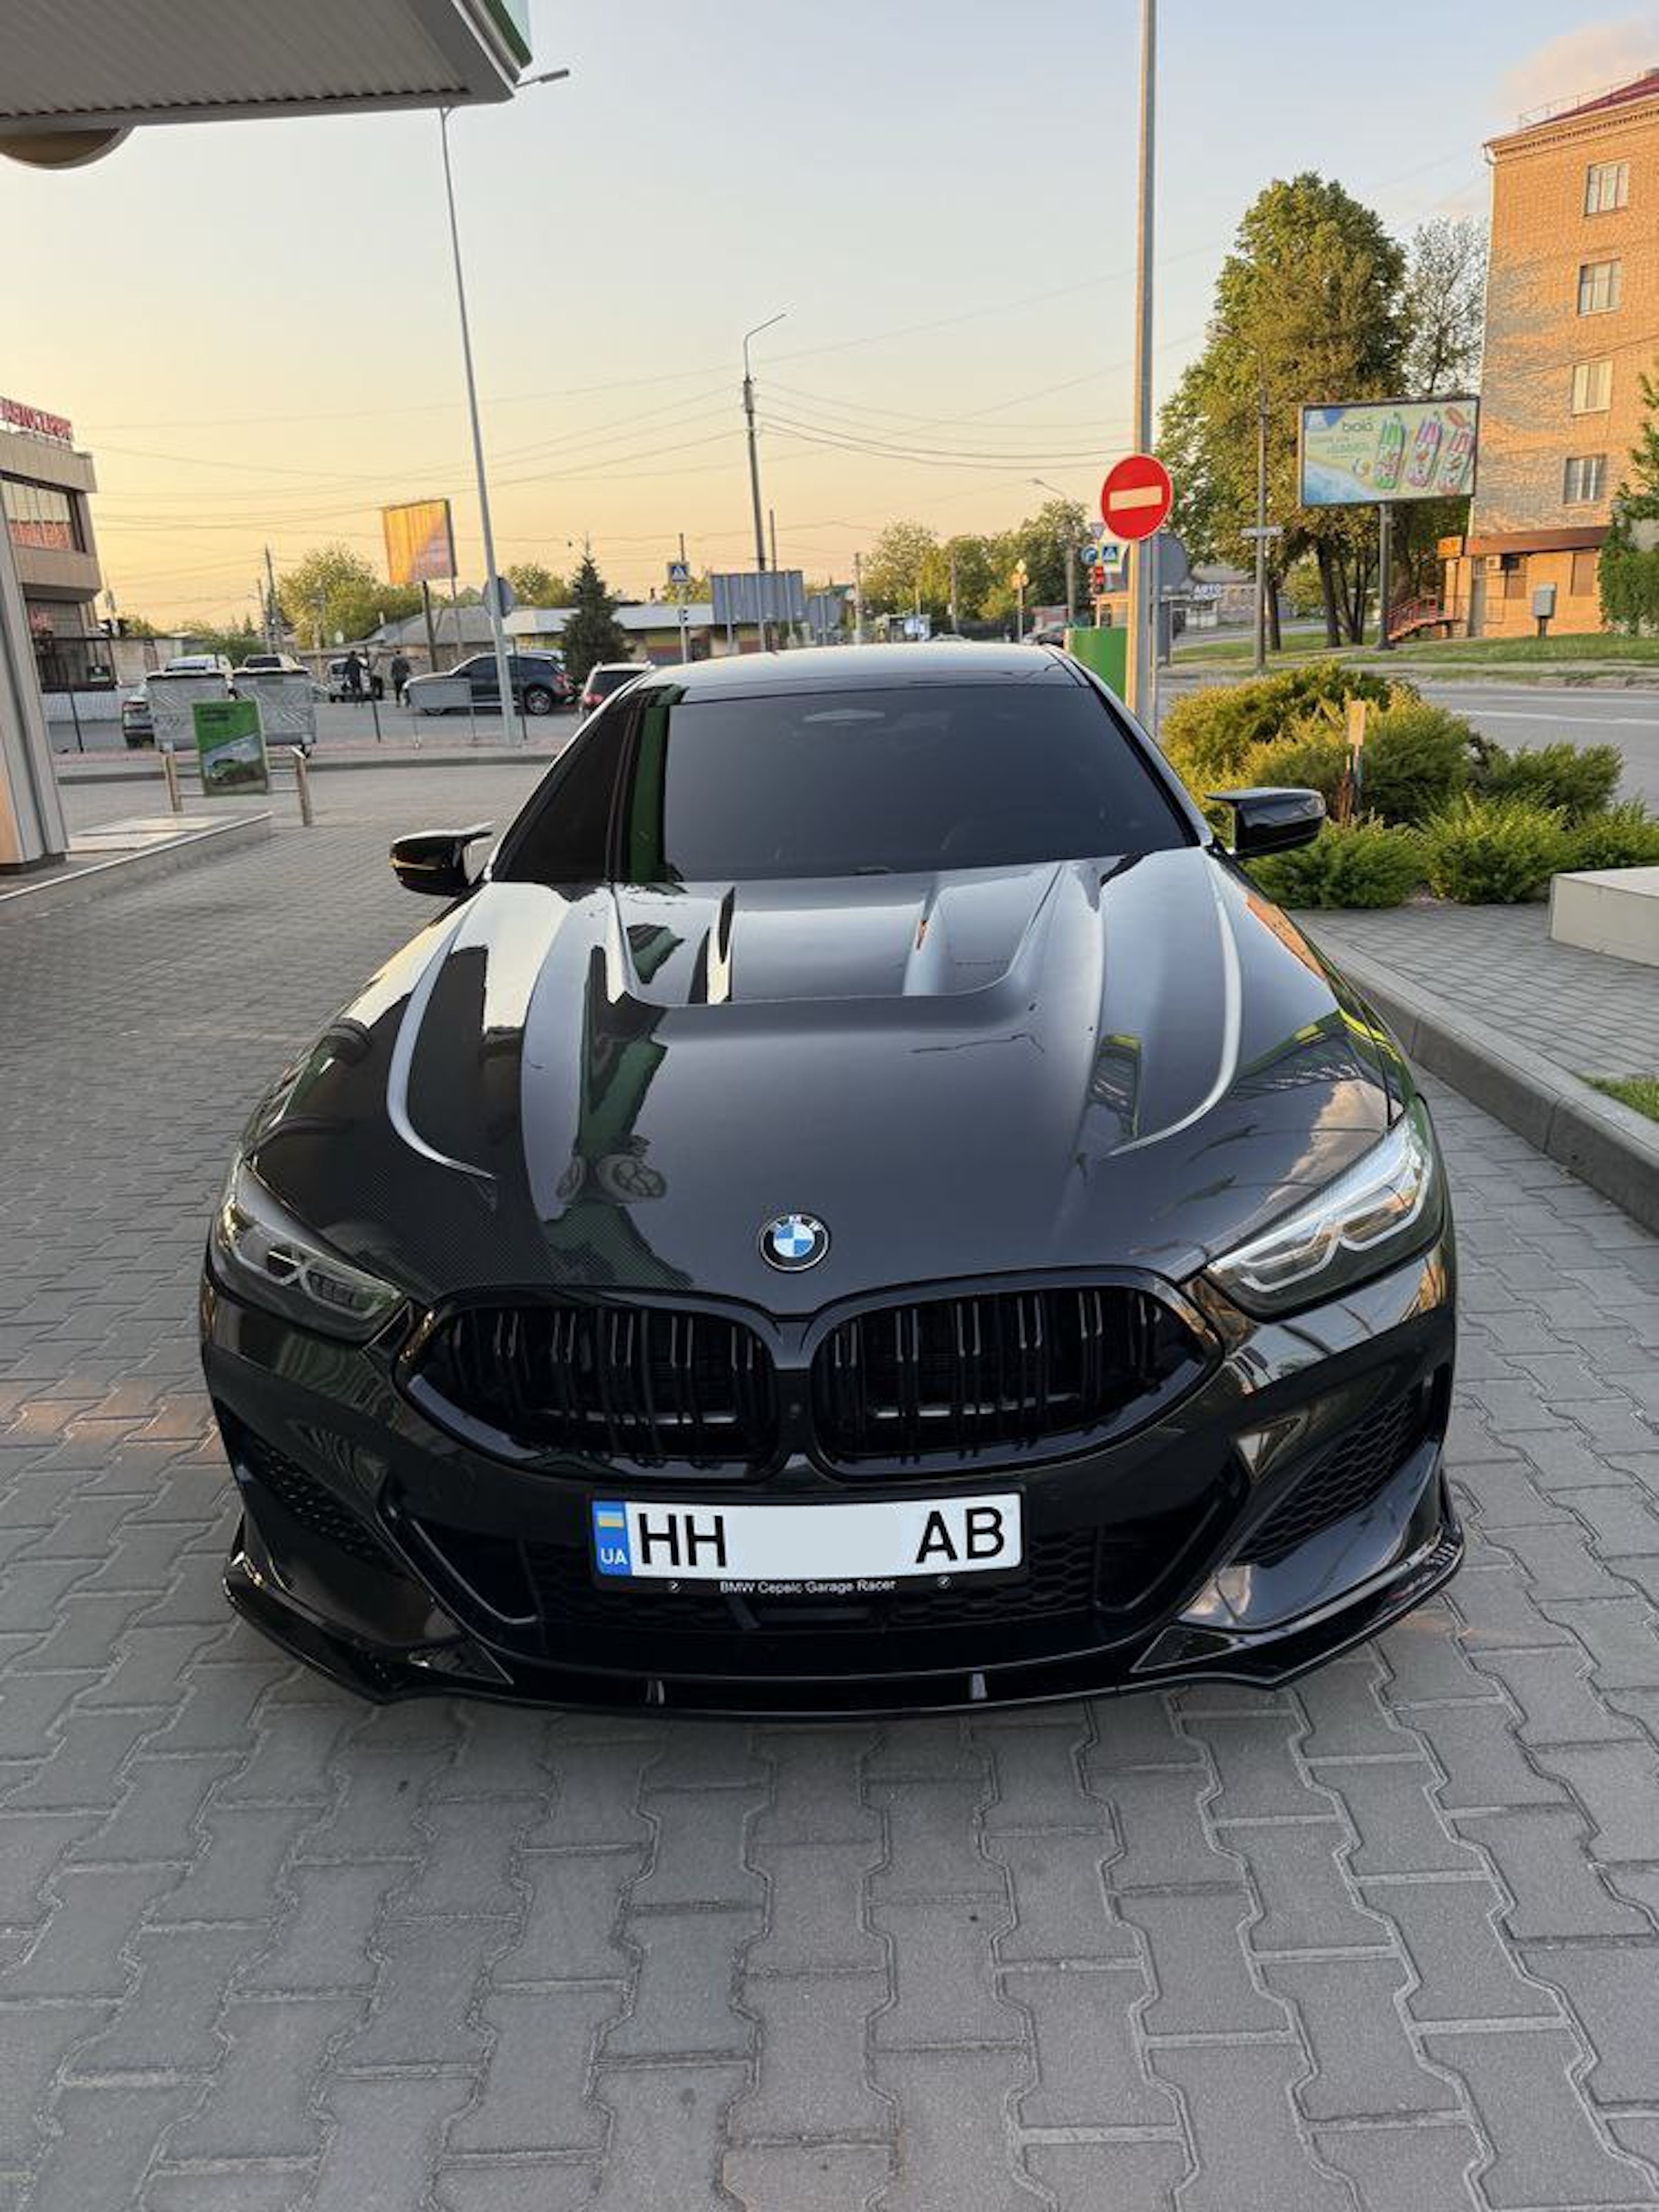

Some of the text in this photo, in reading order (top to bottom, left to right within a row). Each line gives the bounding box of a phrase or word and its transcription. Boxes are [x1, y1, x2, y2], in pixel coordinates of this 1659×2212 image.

[638, 1507, 1004, 1566] HH AB
[600, 1547, 629, 1565] UA
[720, 1581, 755, 1593] BMW
[805, 1581, 854, 1596] Garage
[857, 1579, 897, 1592] Racer
